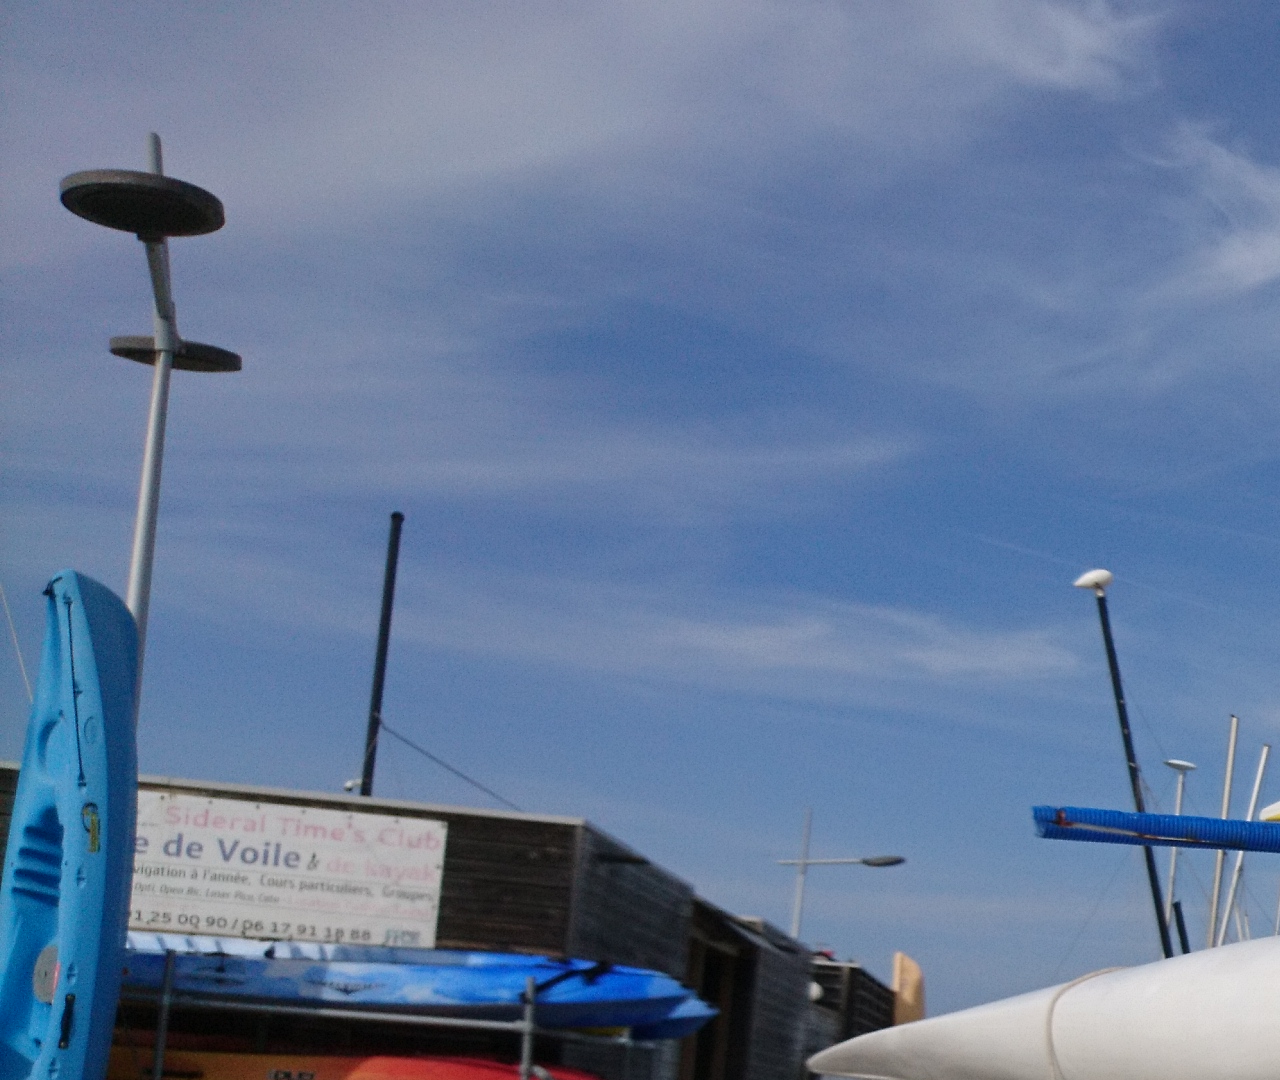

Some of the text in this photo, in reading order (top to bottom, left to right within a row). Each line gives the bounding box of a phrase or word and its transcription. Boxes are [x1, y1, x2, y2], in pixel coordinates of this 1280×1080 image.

[165, 804, 266, 833] Sideral
[377, 826, 442, 851] Club
[162, 832, 204, 859] de
[217, 837, 300, 868] Voile
[132, 864, 186, 879] vigation
[205, 915, 228, 928] 90
